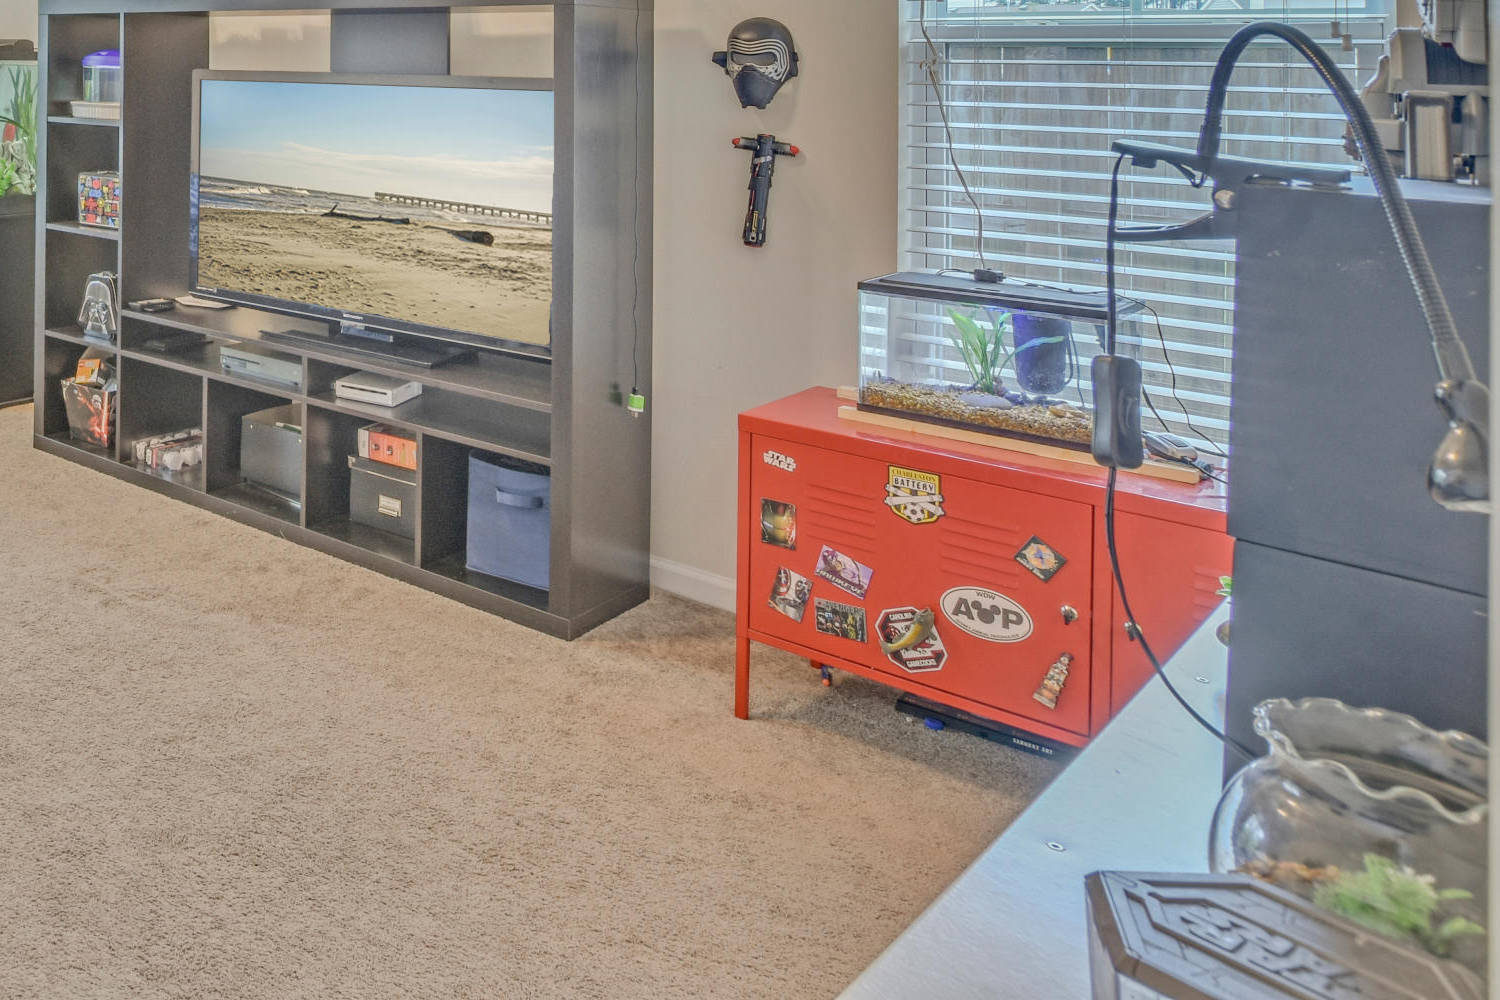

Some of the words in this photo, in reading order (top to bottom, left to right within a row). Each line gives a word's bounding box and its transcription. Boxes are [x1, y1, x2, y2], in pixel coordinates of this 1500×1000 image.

[764, 450, 794, 463] STAR
[764, 457, 797, 472] WARS
[892, 468, 937, 482] CHARLESTON
[894, 477, 934, 492] BATTERY
[975, 591, 996, 601] WDW
